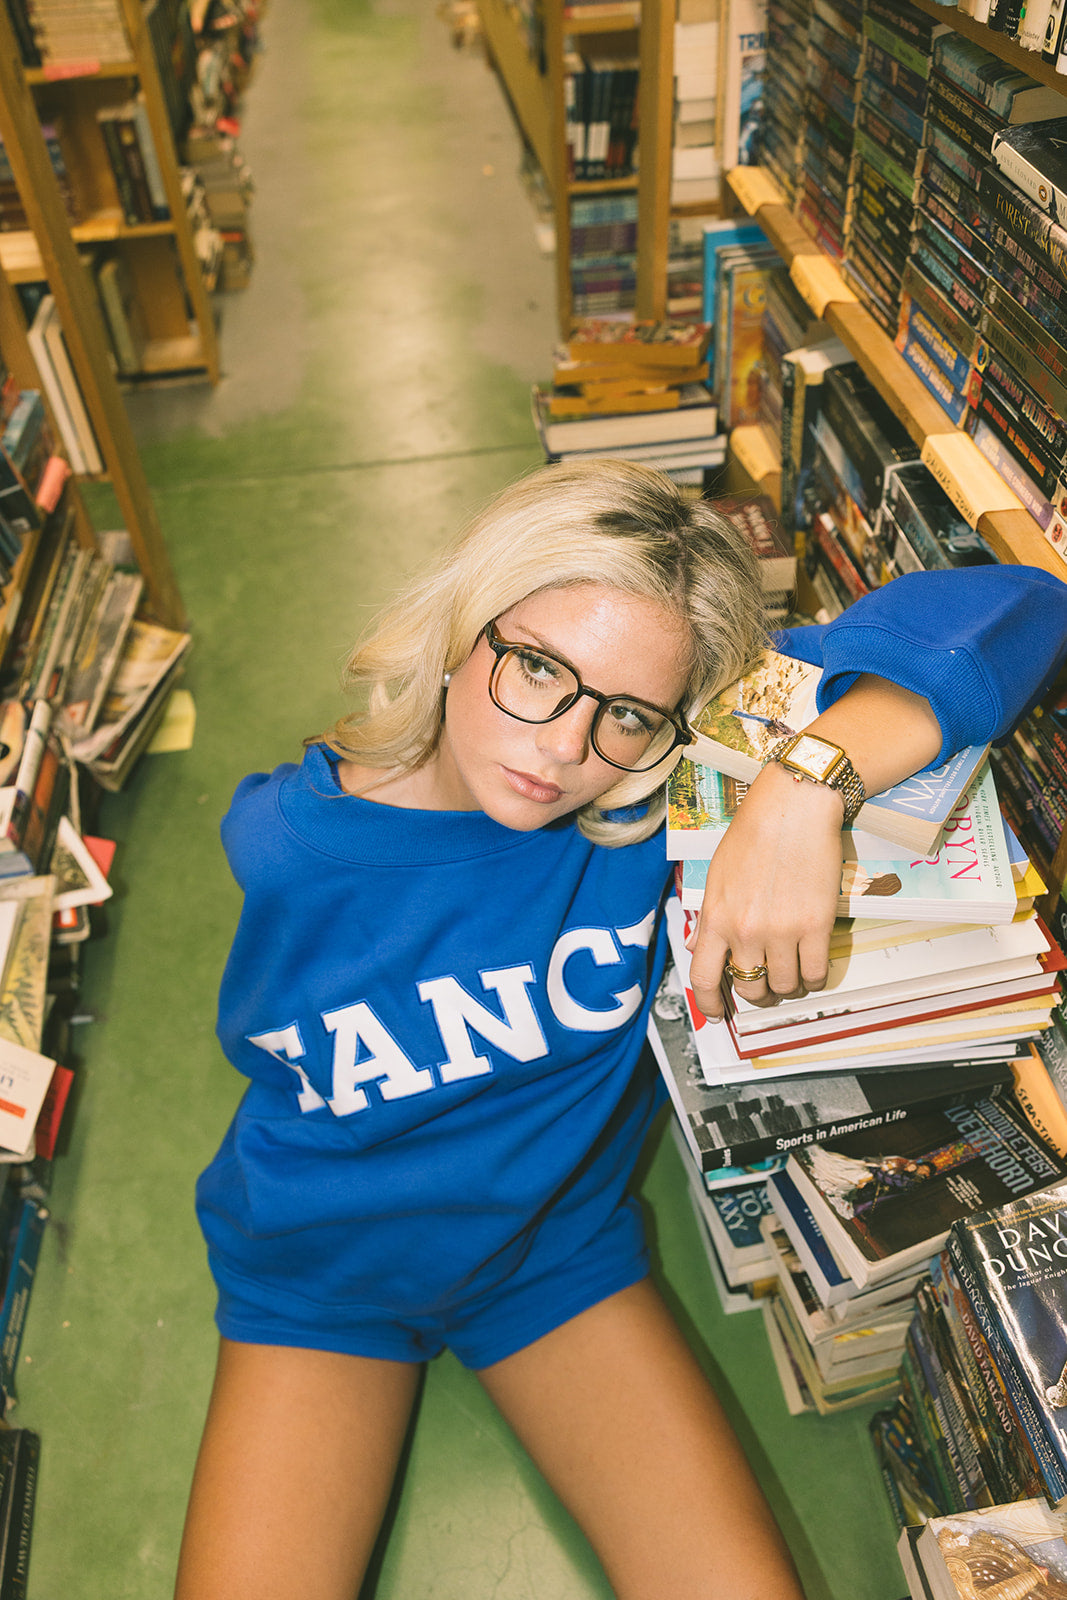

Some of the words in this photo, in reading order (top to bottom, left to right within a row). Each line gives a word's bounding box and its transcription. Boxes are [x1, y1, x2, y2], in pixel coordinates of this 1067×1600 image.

[996, 194, 1032, 238] FOREST
[1021, 395, 1060, 445] SOLDIERS
[775, 1132, 814, 1151] Sports
[814, 1128, 827, 1141] in
[828, 1114, 882, 1138] American
[884, 1108, 907, 1124] Life
[1018, 1146, 1058, 1179] FEIST
[998, 1212, 1067, 1249] DAV
[1003, 1283, 1016, 1292] The
[1019, 1276, 1043, 1289] Jaguar
[1016, 1270, 1042, 1281] Author
[1044, 1265, 1053, 1273] of
[958, 1266, 995, 1340] DUNCAN
[963, 1313, 985, 1359] DAVID
[981, 1360, 1013, 1435] FARLAND
